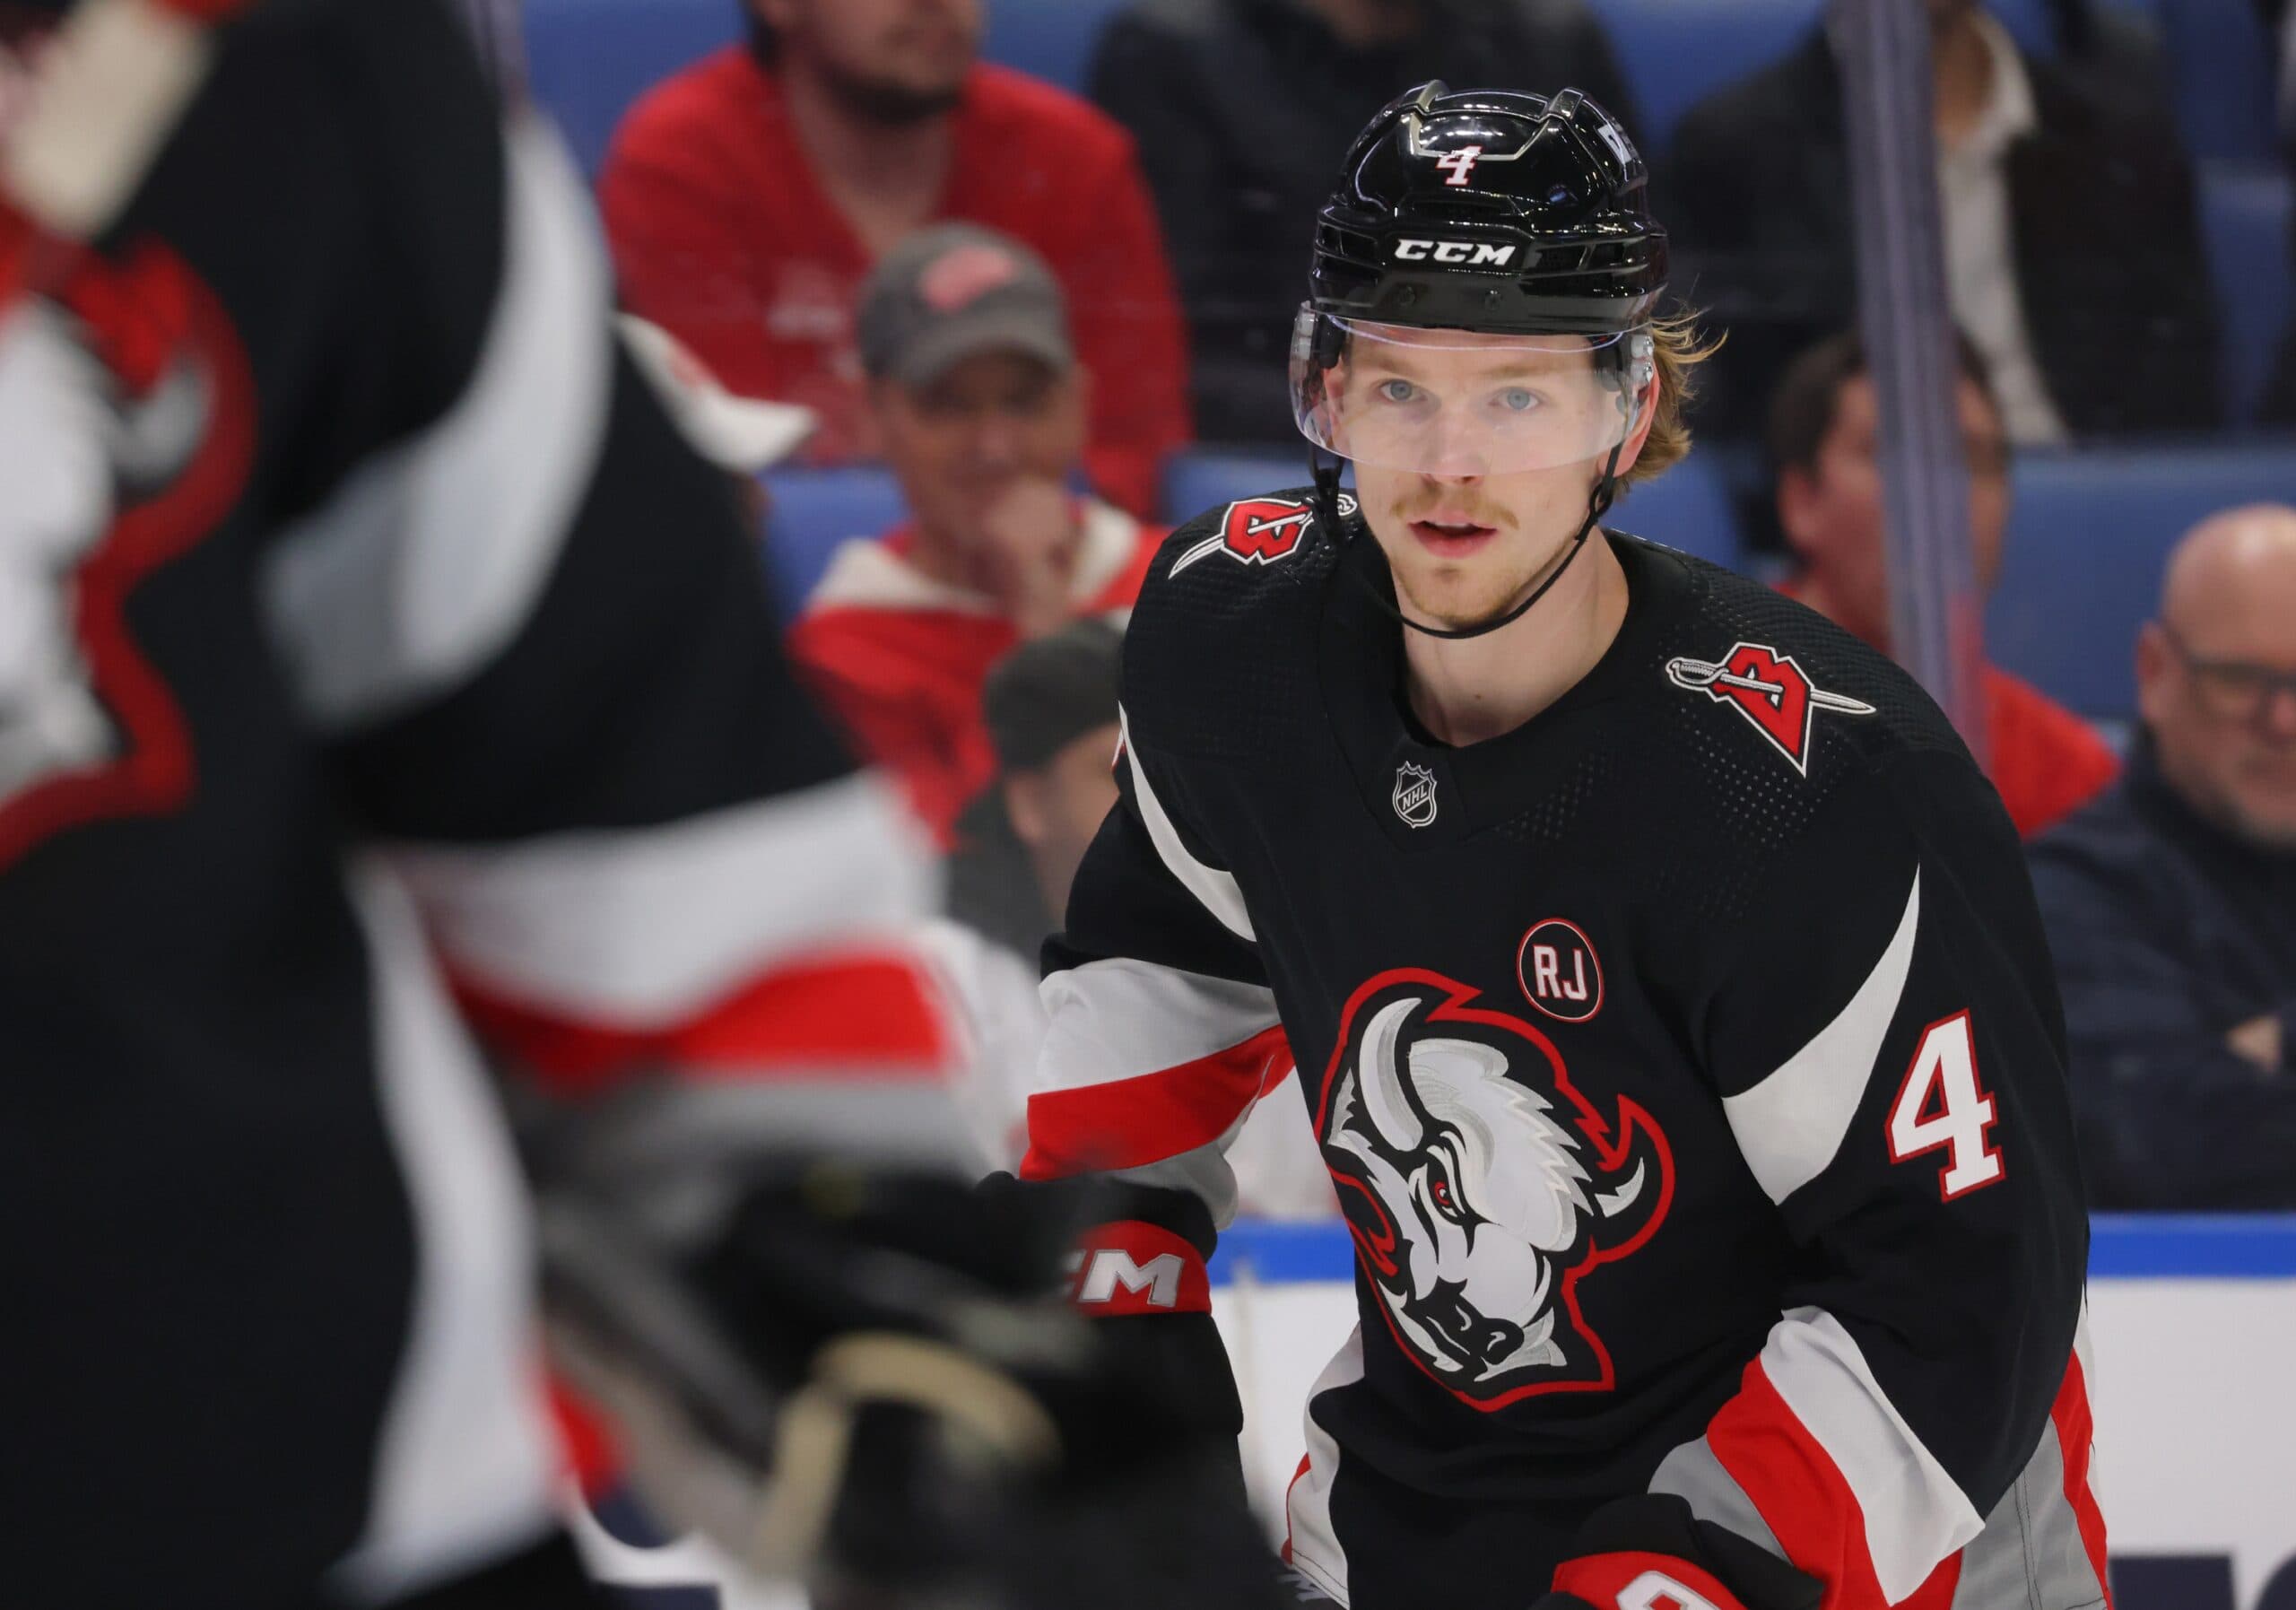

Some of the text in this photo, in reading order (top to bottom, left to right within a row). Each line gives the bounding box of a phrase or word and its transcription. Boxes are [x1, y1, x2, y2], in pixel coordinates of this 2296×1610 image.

[1436, 144, 1483, 187] 4
[1394, 238, 1517, 266] CCM
[1402, 784, 1428, 811] NHL
[1533, 944, 1587, 1001] RJ
[1884, 1007, 2006, 1203] 4
